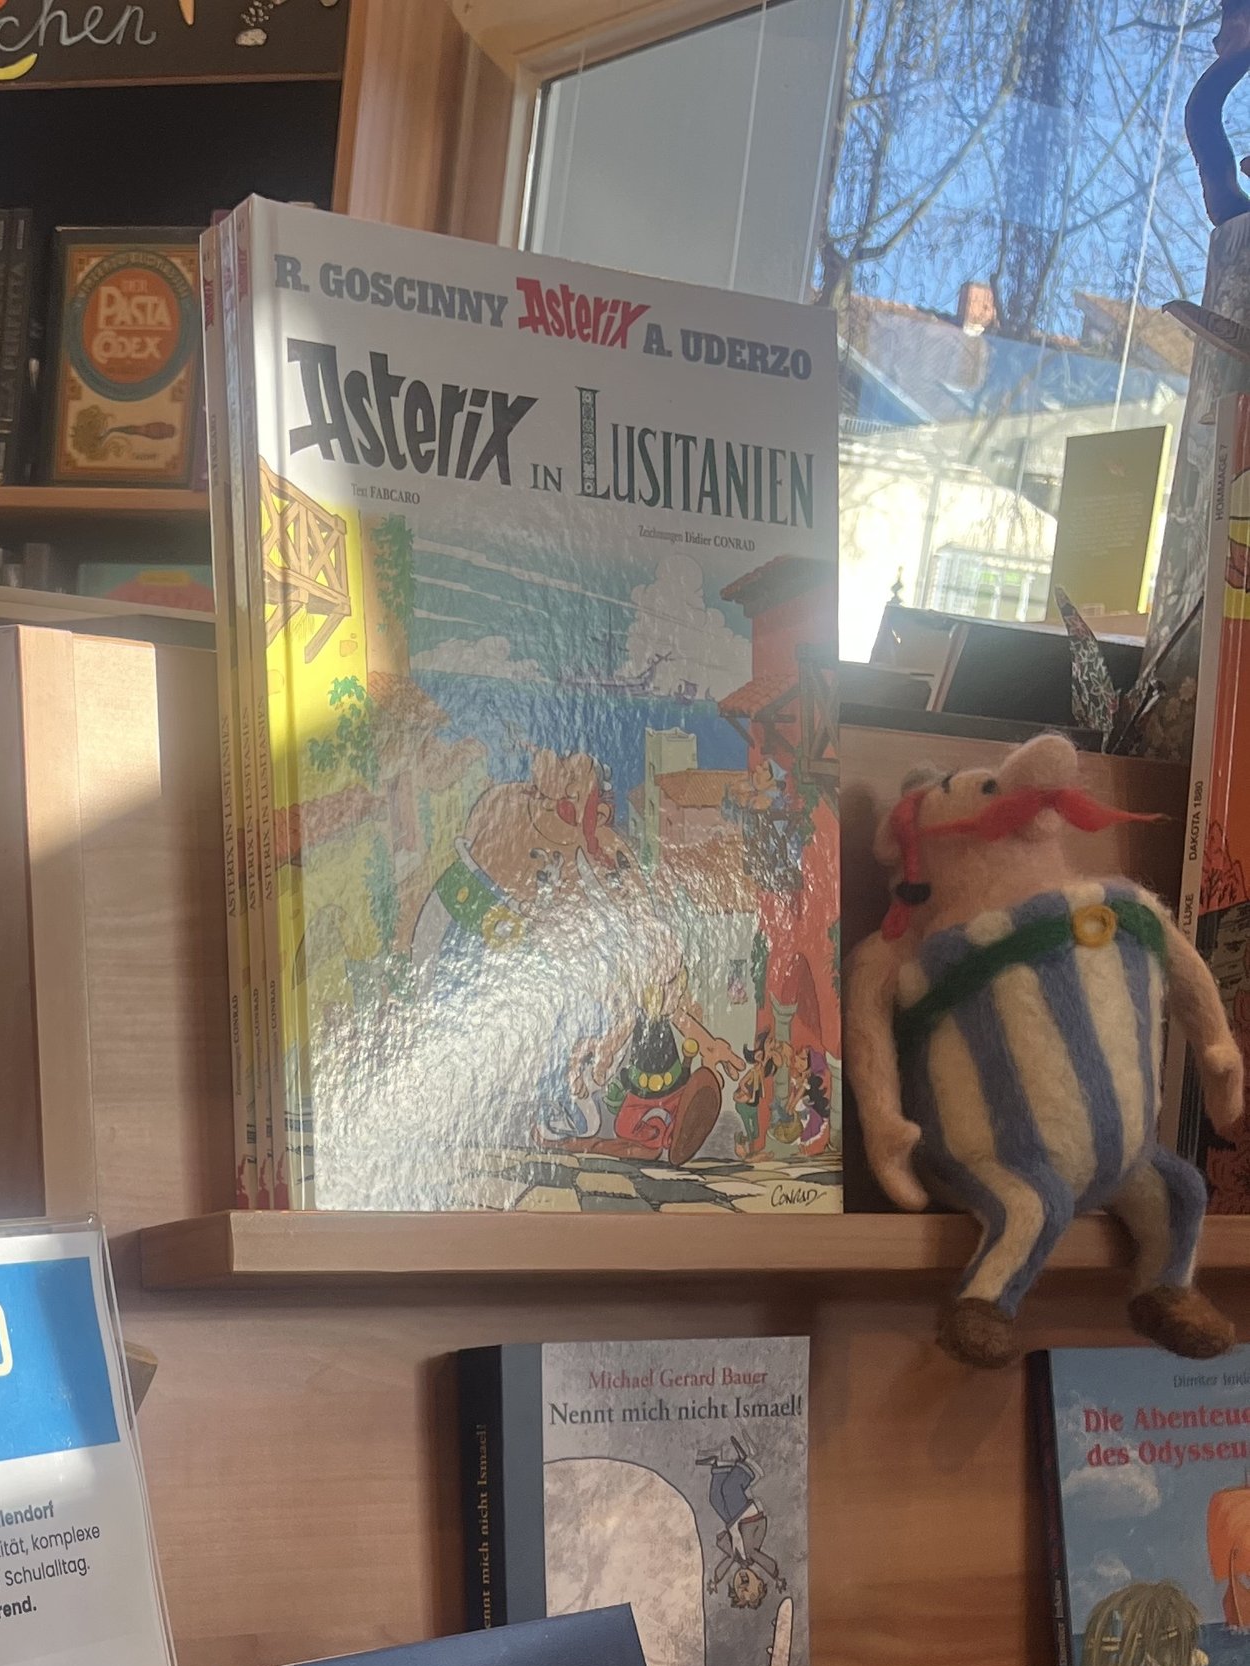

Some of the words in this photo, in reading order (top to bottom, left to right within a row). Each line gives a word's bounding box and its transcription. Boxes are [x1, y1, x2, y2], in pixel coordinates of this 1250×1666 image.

[100, 286, 172, 329] PASTA
[274, 254, 310, 292] R.
[319, 262, 509, 328] GOSCINNY
[516, 276, 652, 350] Asterix
[643, 323, 672, 358] A.
[680, 328, 812, 380] UDERZO
[92, 331, 163, 364] CODEX
[286, 338, 539, 486] Asterix
[529, 463, 563, 493] IN
[575, 386, 814, 529] LUSITANIEN
[370, 485, 421, 506] FABCARO
[1213, 455, 1227, 522] HOMMAGE
[638, 524, 684, 544] Zeichnungen
[685, 531, 712, 547] Didier
[713, 534, 756, 553] CONRAD
[220, 715, 233, 819] LUSITANIEN
[240, 708, 253, 812] LUSITANIEN
[256, 697, 269, 801] LUSITANIEN
[1192, 780, 1204, 809] 1880
[1188, 812, 1202, 861] DAKOTA
[226, 846, 237, 918] ASTERIX
[246, 839, 257, 911] ASTERIX
[261, 830, 273, 901] ASTERIX
[1183, 893, 1195, 924] LUKE
[231, 994, 239, 1044] CONRAD
[251, 988, 260, 1037] CONRAD
[268, 979, 278, 1029] CONRAD
[588, 1370, 655, 1391] Michael
[658, 1369, 716, 1388] Gerard
[720, 1367, 768, 1386] Bauer
[550, 1402, 614, 1425] Nennt
[622, 1399, 671, 1422] mich
[677, 1397, 728, 1421] nicht
[734, 1395, 803, 1420] Ismael!
[1083, 1406, 1124, 1433] Die
[1135, 1405, 1250, 1431] Abenteue
[476, 1424, 488, 1486] Ismael!
[1087, 1444, 1130, 1467] des
[1138, 1439, 1250, 1472] Odysseu
[478, 1492, 489, 1535] nicht
[30, 1525, 101, 1551] komplexe
[4, 1557, 91, 1587] Schulalltag.
[478, 1541, 490, 1585] mich
